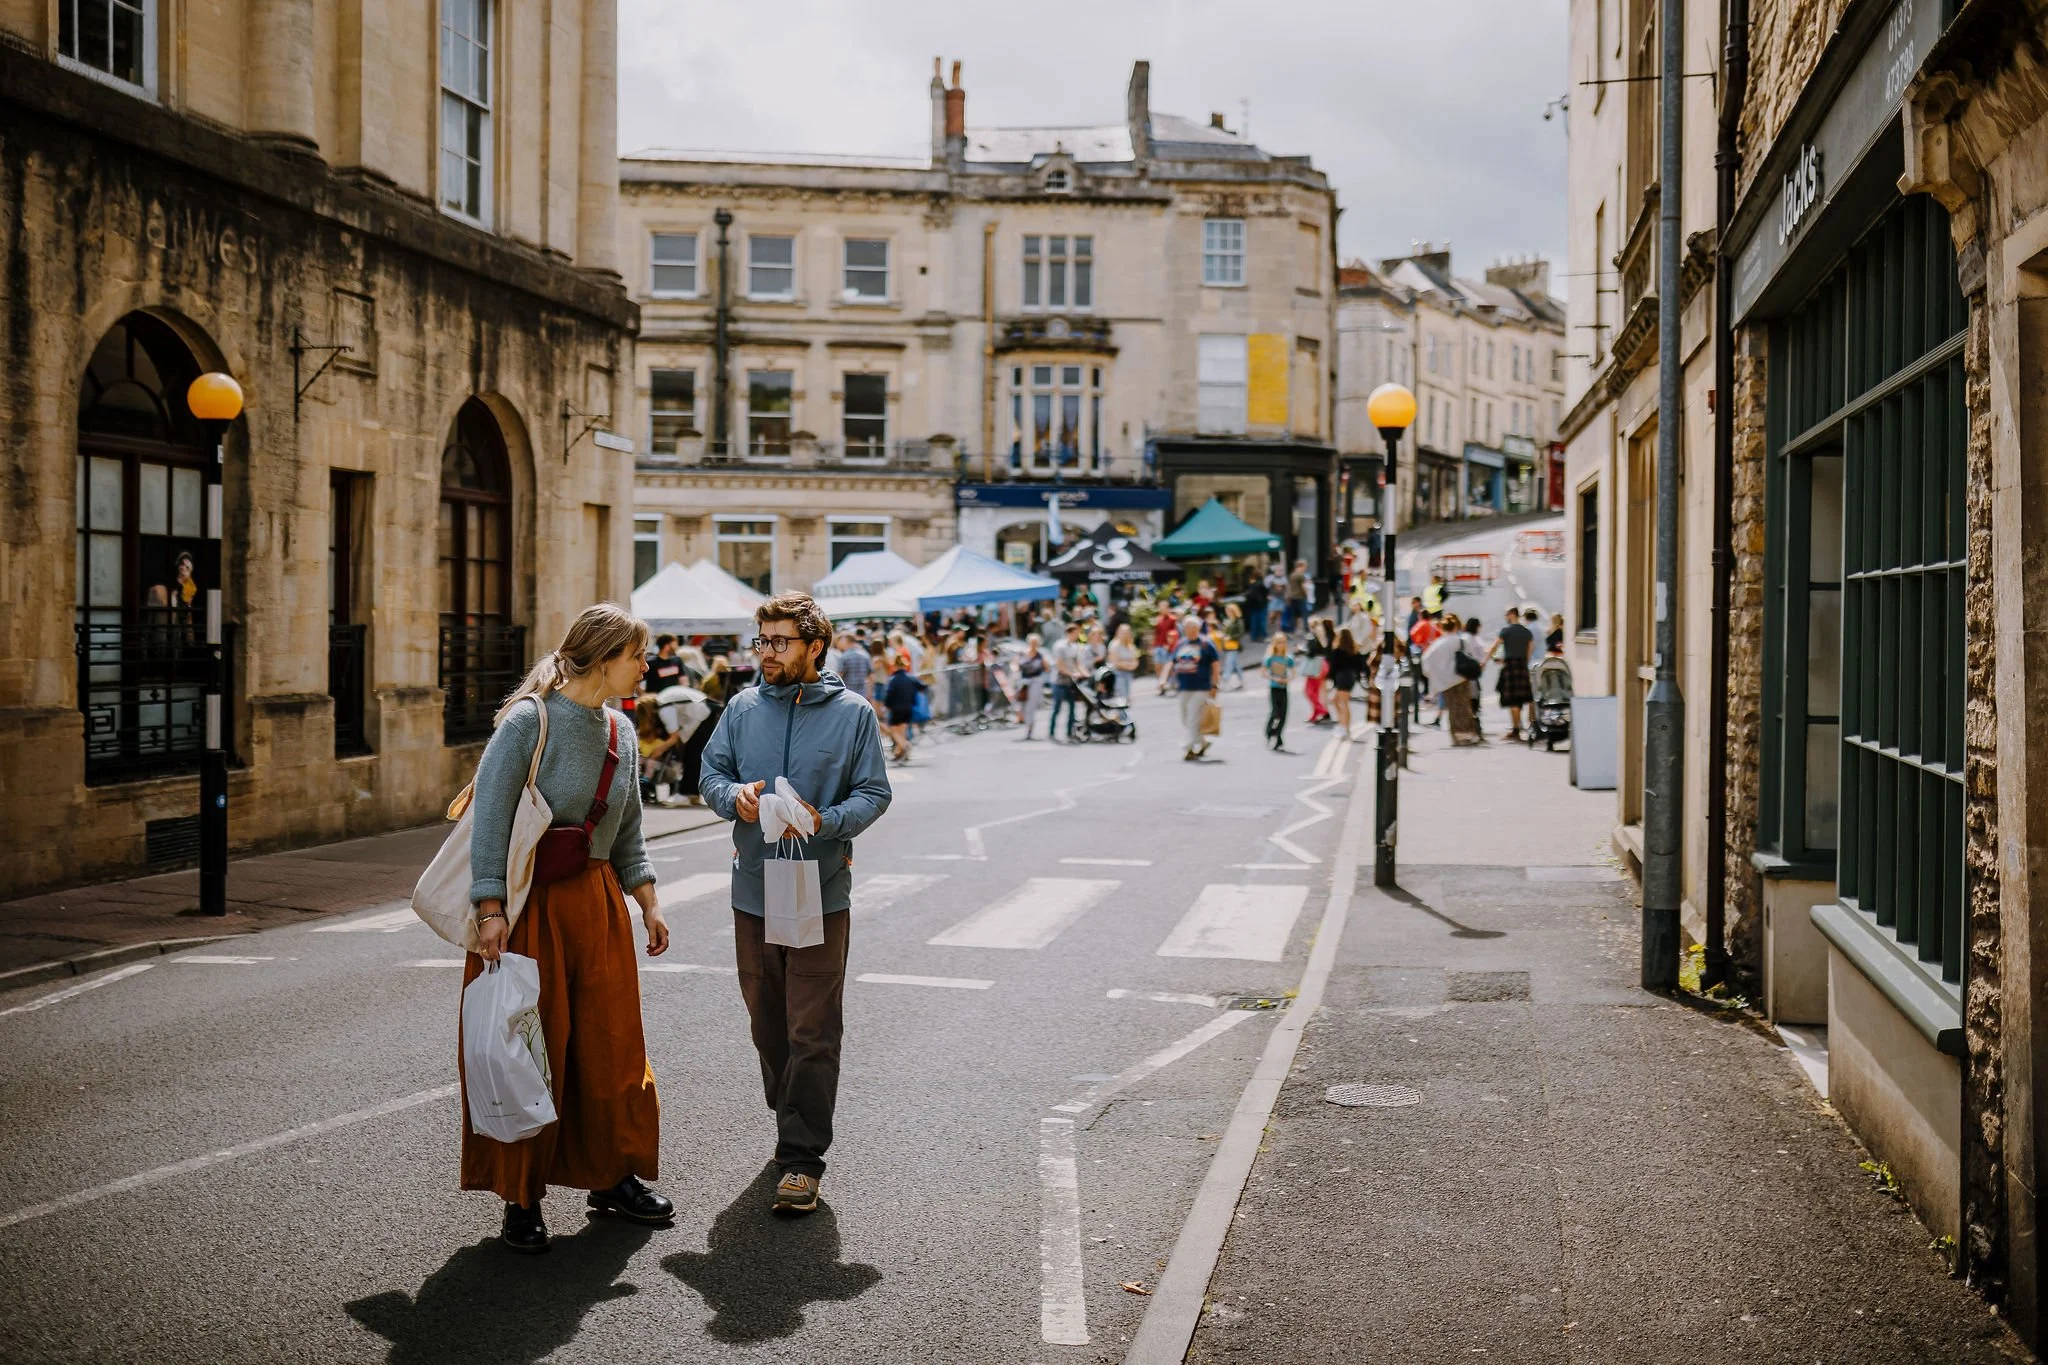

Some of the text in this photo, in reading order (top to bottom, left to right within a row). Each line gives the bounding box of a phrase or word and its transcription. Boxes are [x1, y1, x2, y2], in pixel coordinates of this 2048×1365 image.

[1888, 0, 1913, 52] 01373
[1885, 40, 1914, 102] 473798
[1779, 144, 1817, 246] Jacks
